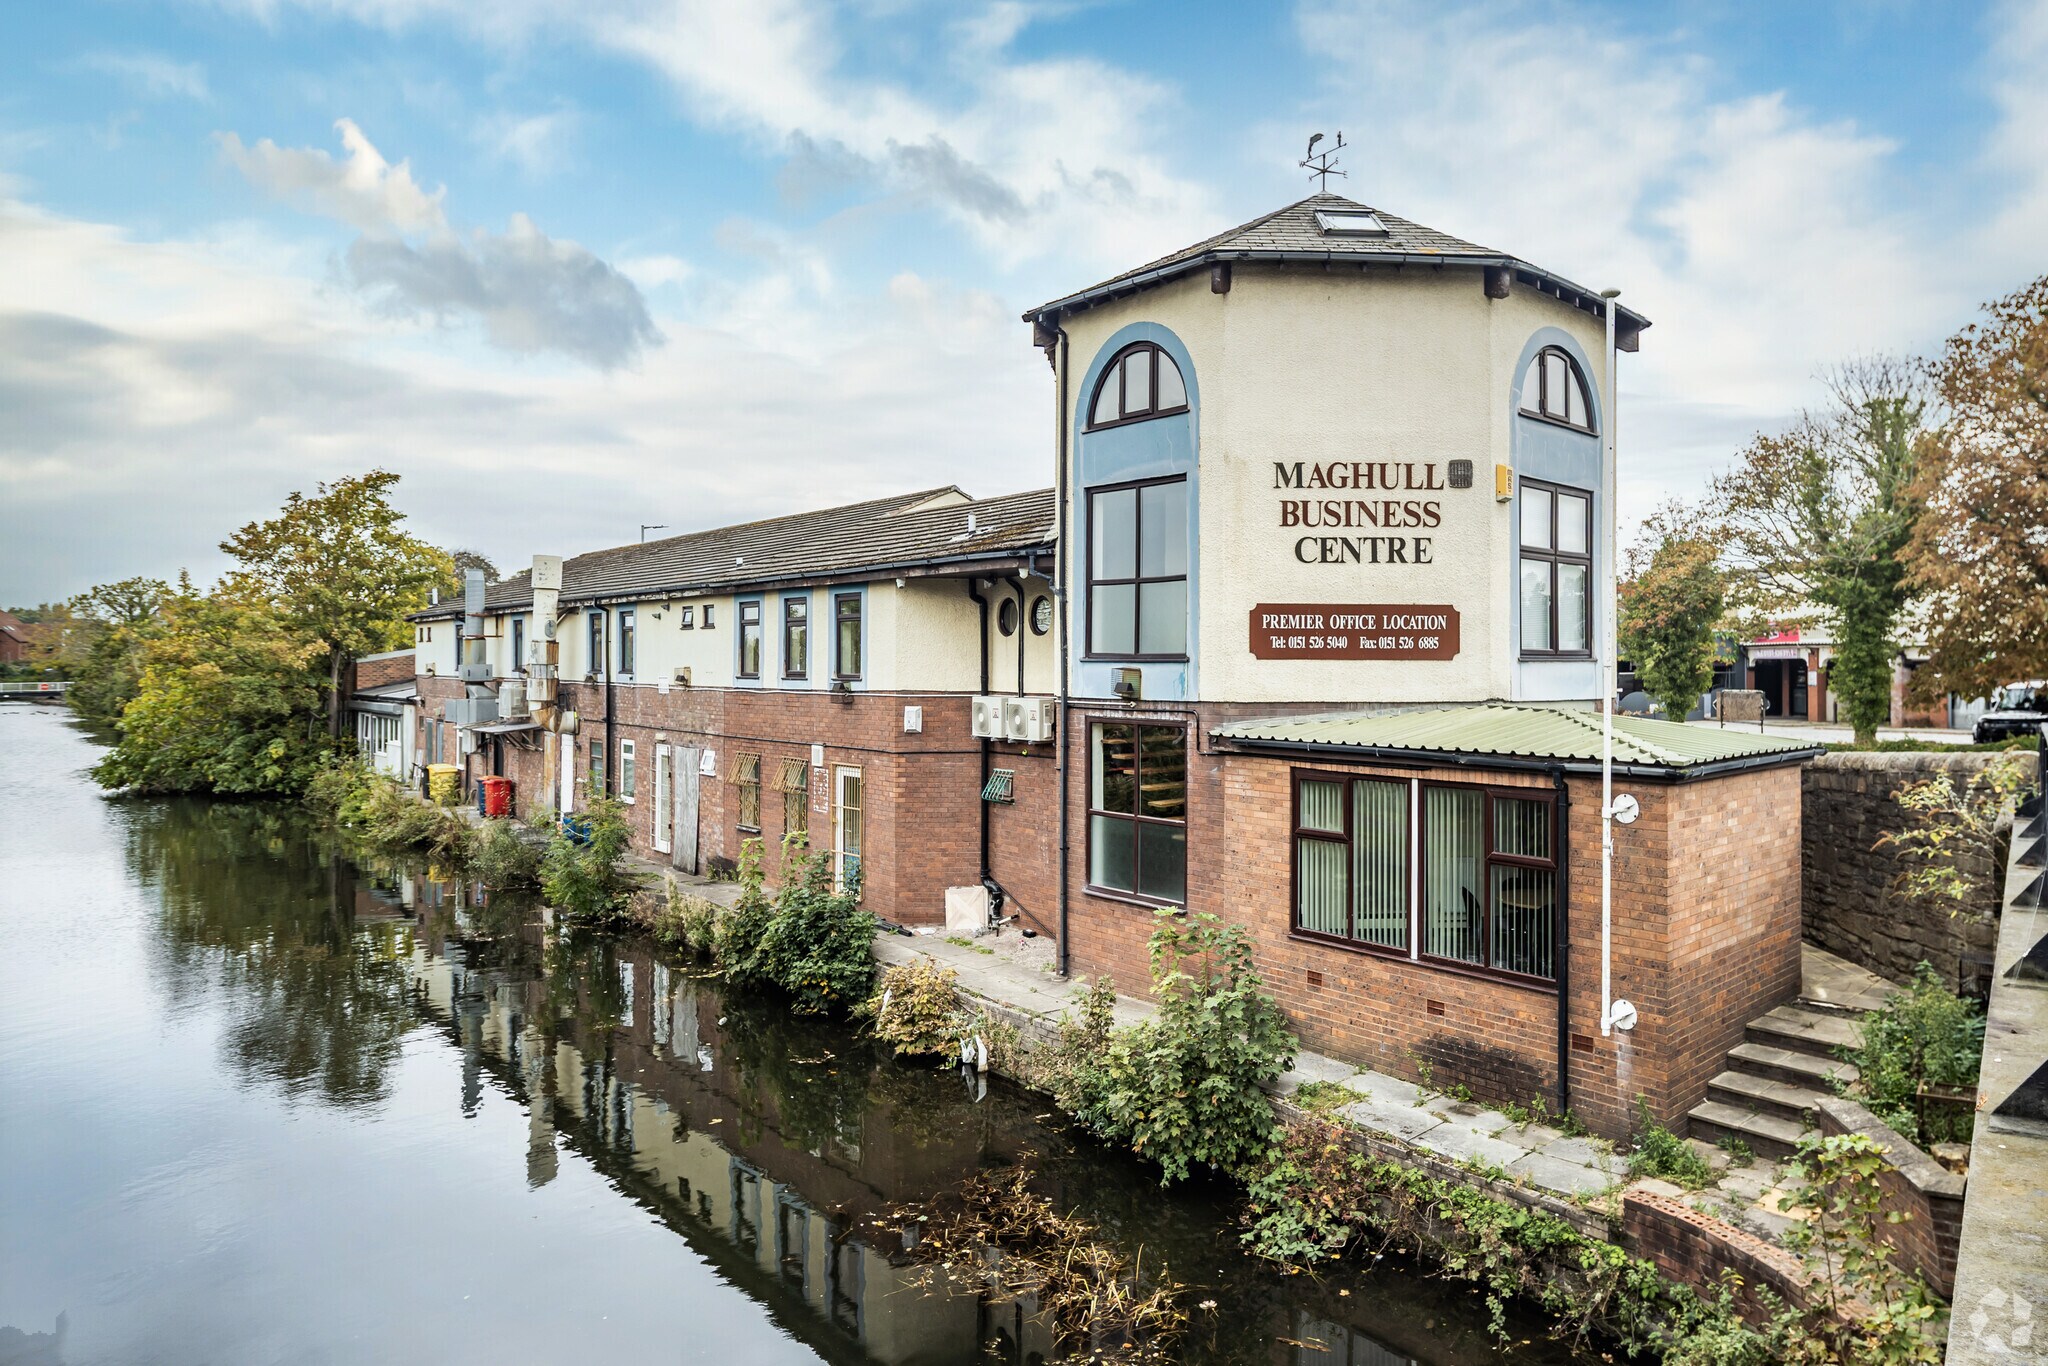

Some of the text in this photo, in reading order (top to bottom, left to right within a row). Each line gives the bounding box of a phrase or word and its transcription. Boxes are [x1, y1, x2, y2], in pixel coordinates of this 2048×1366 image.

[1273, 461, 1445, 490] MAGHULL
[1279, 500, 1442, 528] BUSINESS
[1295, 536, 1433, 564] CENTRE
[1262, 614, 1447, 630] PREMIER OFFICE LOCATION
[1270, 636, 1348, 648] Tel: 0151 526 5040
[1360, 636, 1439, 649] Fax: 0151 526 6885
